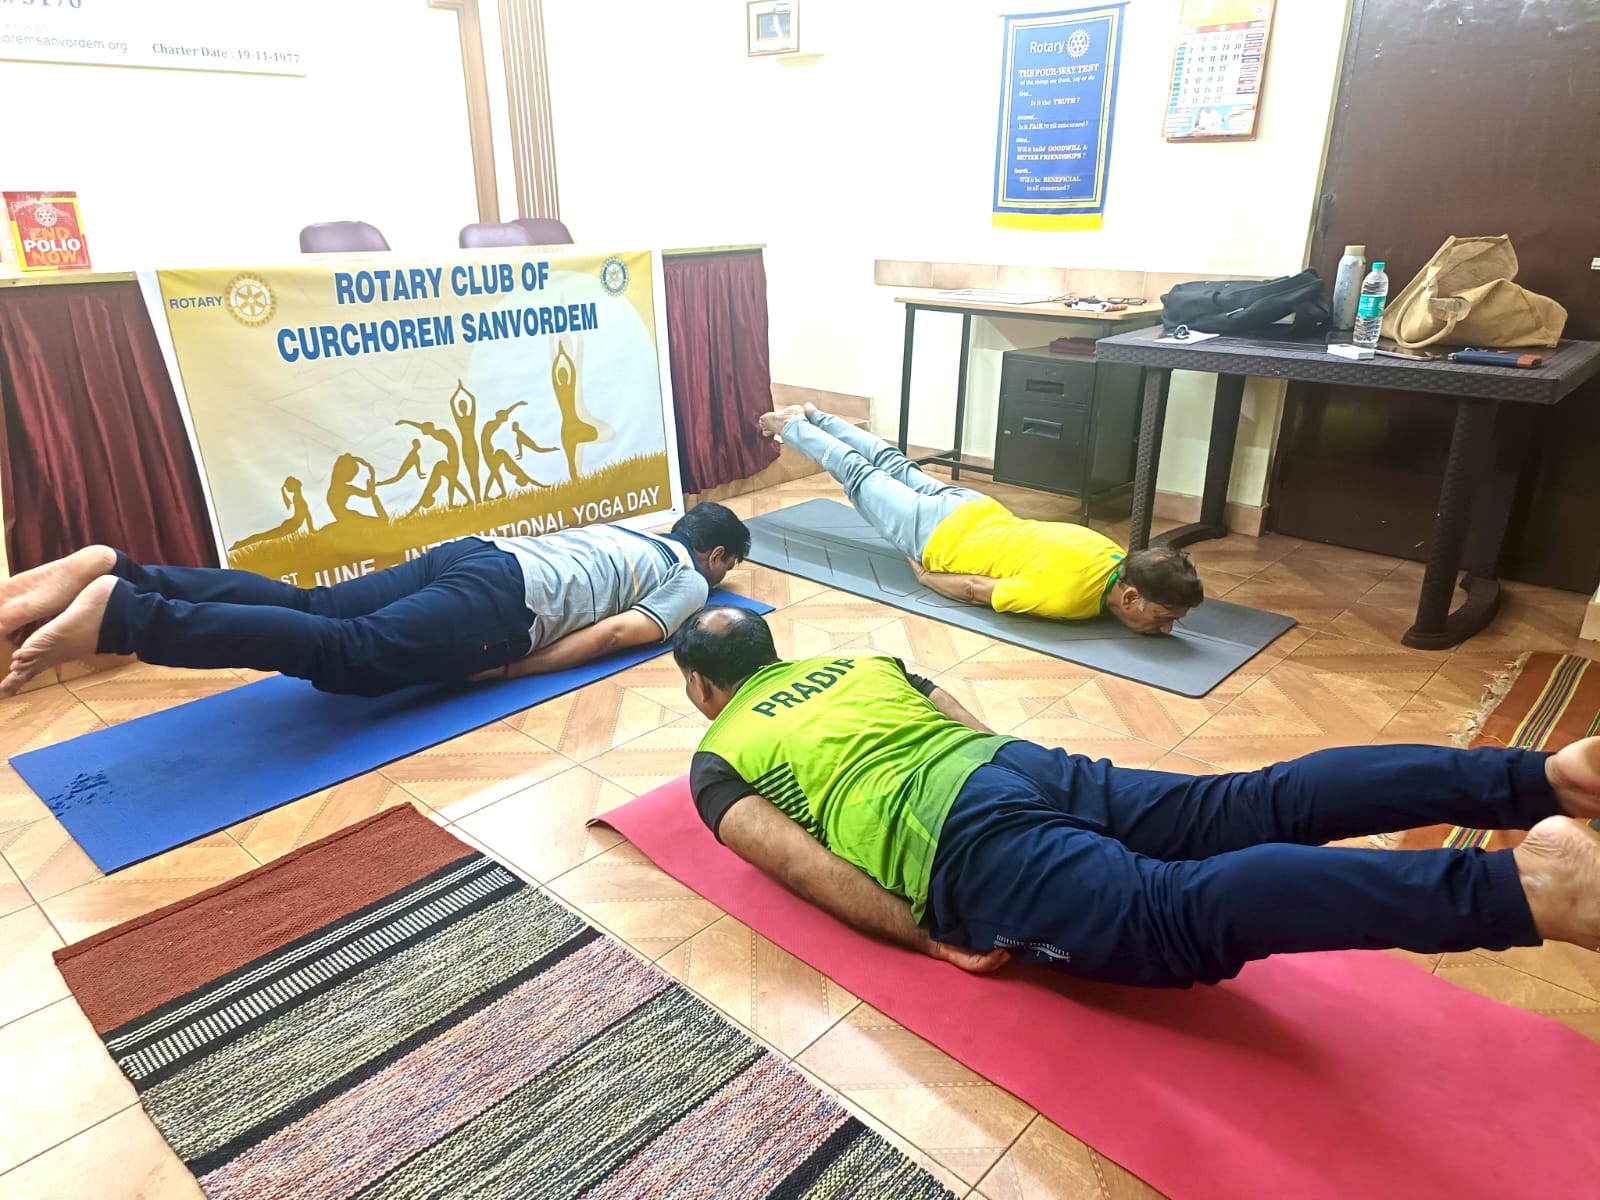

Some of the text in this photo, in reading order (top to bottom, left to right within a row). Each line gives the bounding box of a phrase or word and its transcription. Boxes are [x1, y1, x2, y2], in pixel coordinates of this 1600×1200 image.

[0, 34, 128, 53] oremsanvordem.org
[1030, 41, 1065, 54] Rotary
[152, 43, 198, 56] Charter
[201, 46, 228, 59] Date
[236, 50, 300, 63] 19-11-1977
[1078, 64, 1099, 73] TEST
[28, 228, 70, 240] END
[24, 238, 80, 252] POLIO
[32, 251, 76, 263] NOW
[335, 261, 550, 304] ROTARY CLUB OF
[170, 296, 222, 309] ROTARY
[276, 302, 598, 363] CURCHOREM SANVORDEM
[280, 572, 298, 585] ST
[404, 510, 570, 562] INTIONAL
[572, 496, 624, 524] YOGA
[626, 486, 660, 512] DAY
